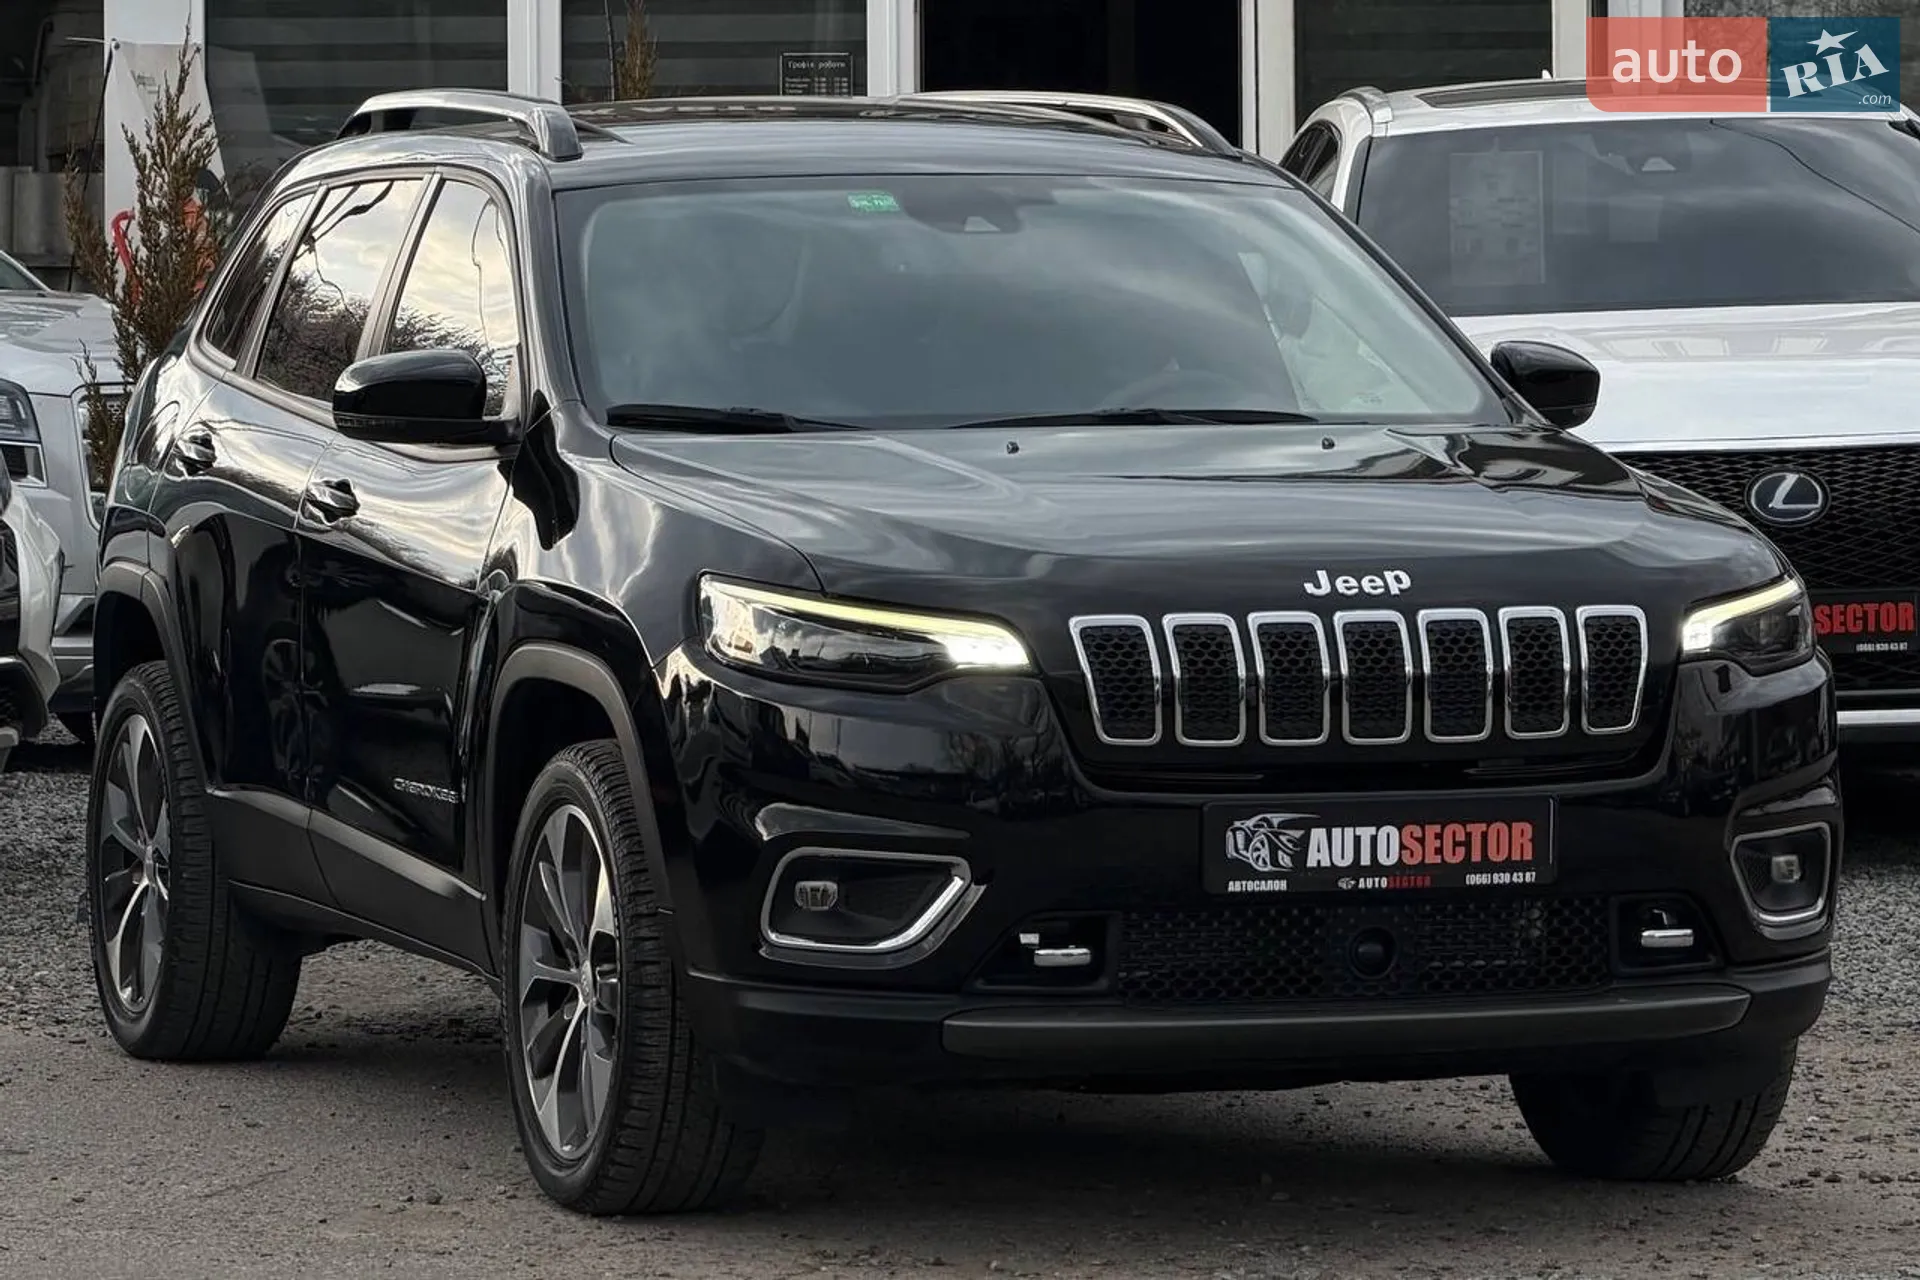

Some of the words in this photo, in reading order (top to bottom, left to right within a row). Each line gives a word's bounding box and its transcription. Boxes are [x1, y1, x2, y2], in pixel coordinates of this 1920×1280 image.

[1303, 570, 1411, 596] Jeep
[394, 778, 459, 803] CHEROKEE
[1306, 822, 1533, 868] AUTOSECTOR
[1228, 879, 1287, 892] АВТОСАЛОН
[1466, 873, 1491, 885] (066)
[1492, 873, 1510, 884] 930
[1512, 872, 1523, 883] 43
[1525, 871, 1536, 882] 87
